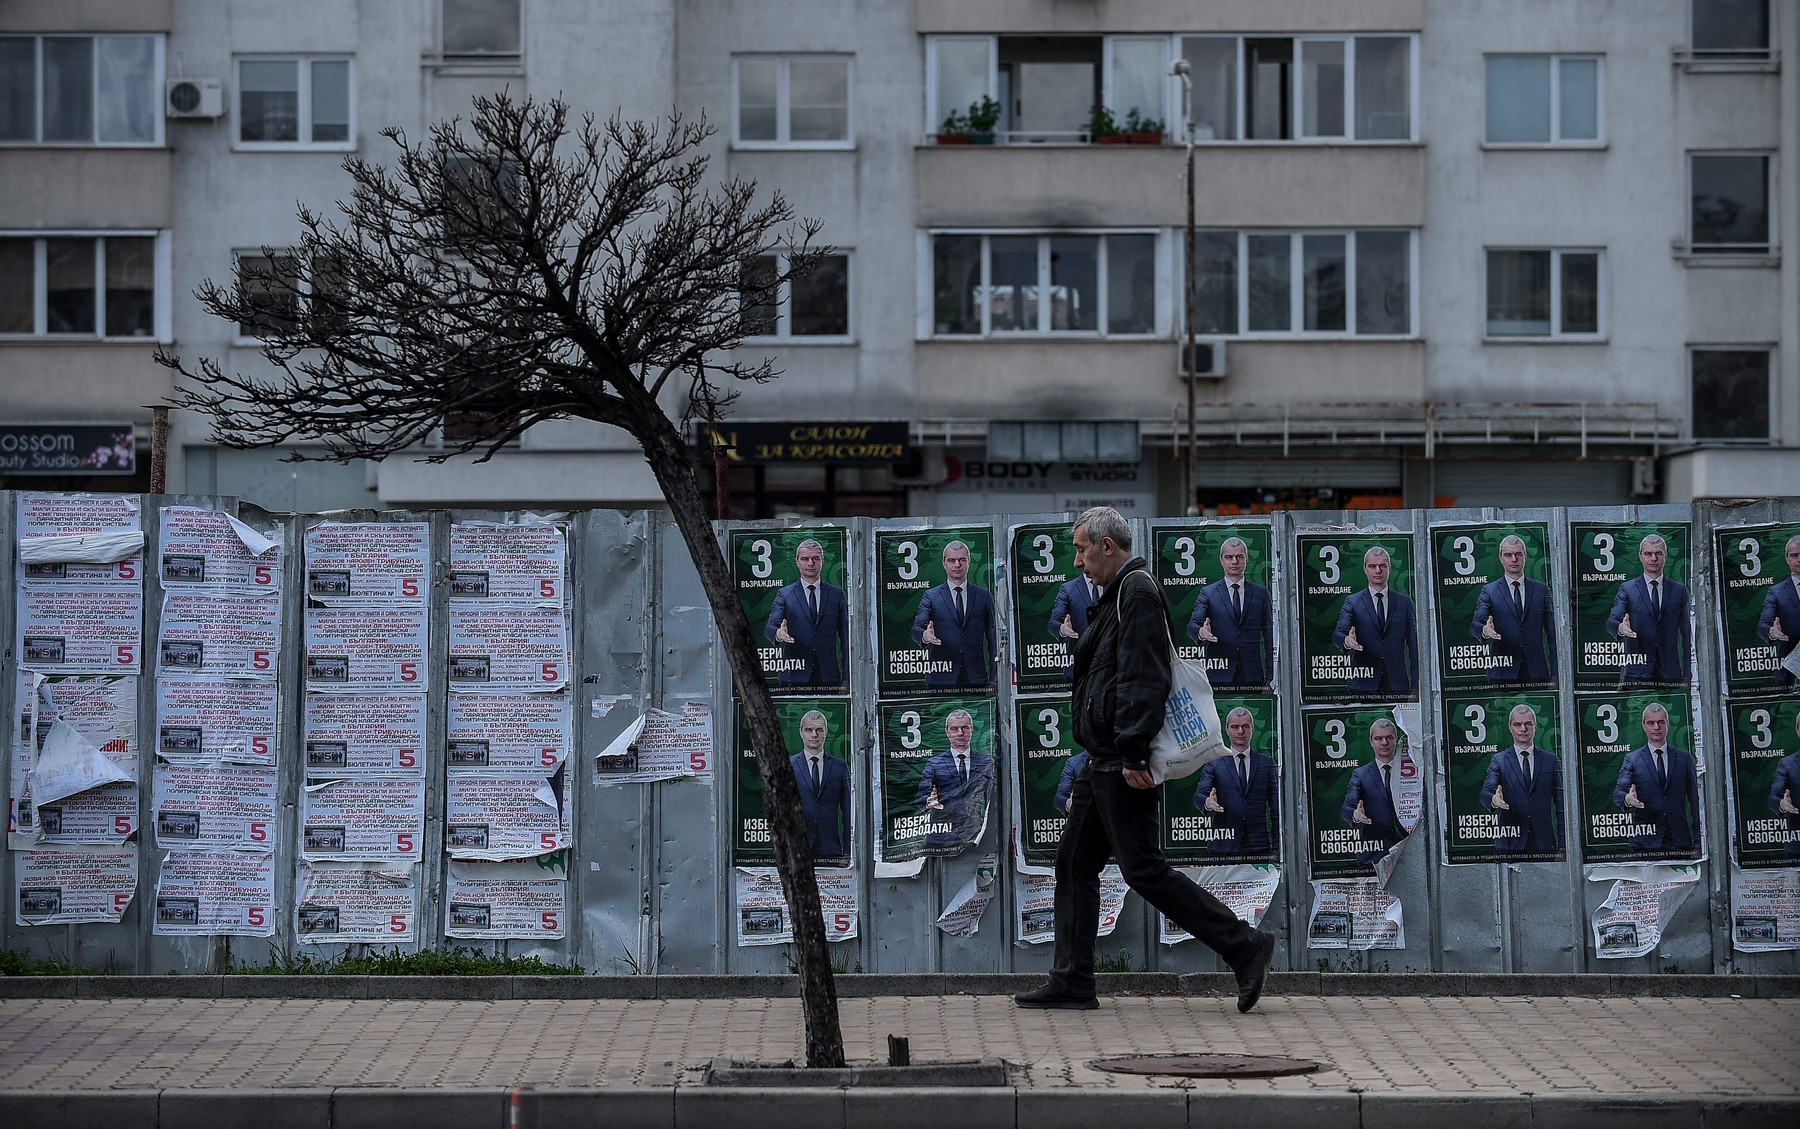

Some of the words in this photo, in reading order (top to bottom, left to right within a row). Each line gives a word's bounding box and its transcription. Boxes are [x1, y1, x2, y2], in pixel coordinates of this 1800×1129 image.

[790, 426, 872, 440] САЛОН
[32, 452, 80, 468] Studio
[965, 462, 1052, 478] BODY
[752, 540, 772, 578] 3
[1033, 535, 1054, 573] 3
[1175, 537, 1195, 575] 3
[1454, 537, 1475, 575] 3
[1594, 533, 1614, 571] 3
[1739, 538, 1761, 576] 3
[898, 542, 918, 579] 3
[1320, 546, 1339, 584] 3
[118, 562, 135, 578] 5
[255, 568, 272, 584] 5
[741, 579, 783, 588] ВЪЗРАЖДАНЕ
[888, 581, 930, 589] ВЪЗРАЖДАНЕ
[1023, 574, 1066, 583] ВЪЗРАЖДАНЕ
[1164, 577, 1206, 586] ВЪЗРАЖДАНЕ
[1444, 576, 1487, 585] ВЪЗРАЖДАНЕ
[1730, 577, 1773, 588] ВЪЗРАЖДАНЕ
[402, 580, 418, 596] 5
[540, 580, 555, 597] 5
[117, 646, 134, 664] 5
[757, 647, 782, 659] БЕРИ
[890, 650, 929, 661] ИЗБЕРИ
[1027, 644, 1066, 655] ИЗБЕРИ
[1179, 646, 1205, 658] БЕРИ
[1450, 644, 1489, 658] ИЗБЕРИ
[1585, 642, 1624, 653] ИЗБЕРИ
[1736, 646, 1777, 660] ИЗБЕРИ
[253, 652, 270, 669] 5
[764, 659, 805, 673] БОДАТА!
[890, 661, 952, 674] СВОБОДАТА!
[1028, 655, 1074, 668] СВОБОДА
[1312, 656, 1351, 667] ИЗБЕРИ
[1451, 656, 1513, 670] СВОБОДАТА!
[1585, 654, 1646, 666] СВОБОДАТА!
[401, 664, 416, 681] 5
[542, 664, 558, 681] 5
[1312, 667, 1374, 680] СВОБОДАТА!
[1166, 686, 1192, 715] ДНА
[1167, 704, 1199, 728] ТОРБА
[1465, 705, 1486, 743] 3
[1597, 704, 1618, 743] 3
[901, 711, 923, 748] 3
[1039, 709, 1059, 747] 3
[1172, 716, 1207, 744] ПАРИ
[1750, 709, 1771, 748] 3
[252, 737, 268, 754] 5
[1325, 720, 1346, 758] 3
[891, 749, 933, 758] ВЪЗРАЖДАНЕ
[1029, 748, 1072, 758] ВЪЗРАЖДАНЕ
[1455, 744, 1498, 753] ВЪЗРАЖДАНЕ
[1587, 744, 1630, 753] ВЪЗРАЖДАНЕ
[1741, 749, 1784, 758] ВЪЗРАЖДАНЕ
[399, 750, 414, 767] 5
[541, 749, 558, 766] 5
[690, 753, 706, 770] 5
[1316, 759, 1358, 768] ВЪЗРАЖДАНЕ
[115, 817, 130, 833] 5
[744, 819, 768, 830] ИЗБЕ
[894, 814, 930, 829] ИЗБЕРИ
[1172, 817, 1211, 829] ИЗБЕРИ
[1459, 814, 1498, 826] ИЗБЕРИ
[1592, 813, 1632, 826] ИЗБЕРИ
[1747, 819, 1787, 831] ИЗБЕРИ
[251, 824, 266, 840] 5
[894, 823, 952, 840] СВОБОДАТА!
[1172, 828, 1234, 841] СВОБОДАТА!
[1320, 829, 1360, 841] ИЗБЕРИ
[1459, 826, 1520, 839] СВОБОДАТА!
[1593, 824, 1656, 838] СВОБОДАТА!
[1748, 830, 1800, 844] СВОБОДАТ
[397, 835, 414, 851] 5
[540, 833, 556, 849] 5
[1321, 840, 1383, 854] СВОБОДАТА!
[248, 908, 264, 925] 5
[391, 916, 406, 932] 5
[543, 913, 558, 929] 5
[835, 915, 850, 931] 5
